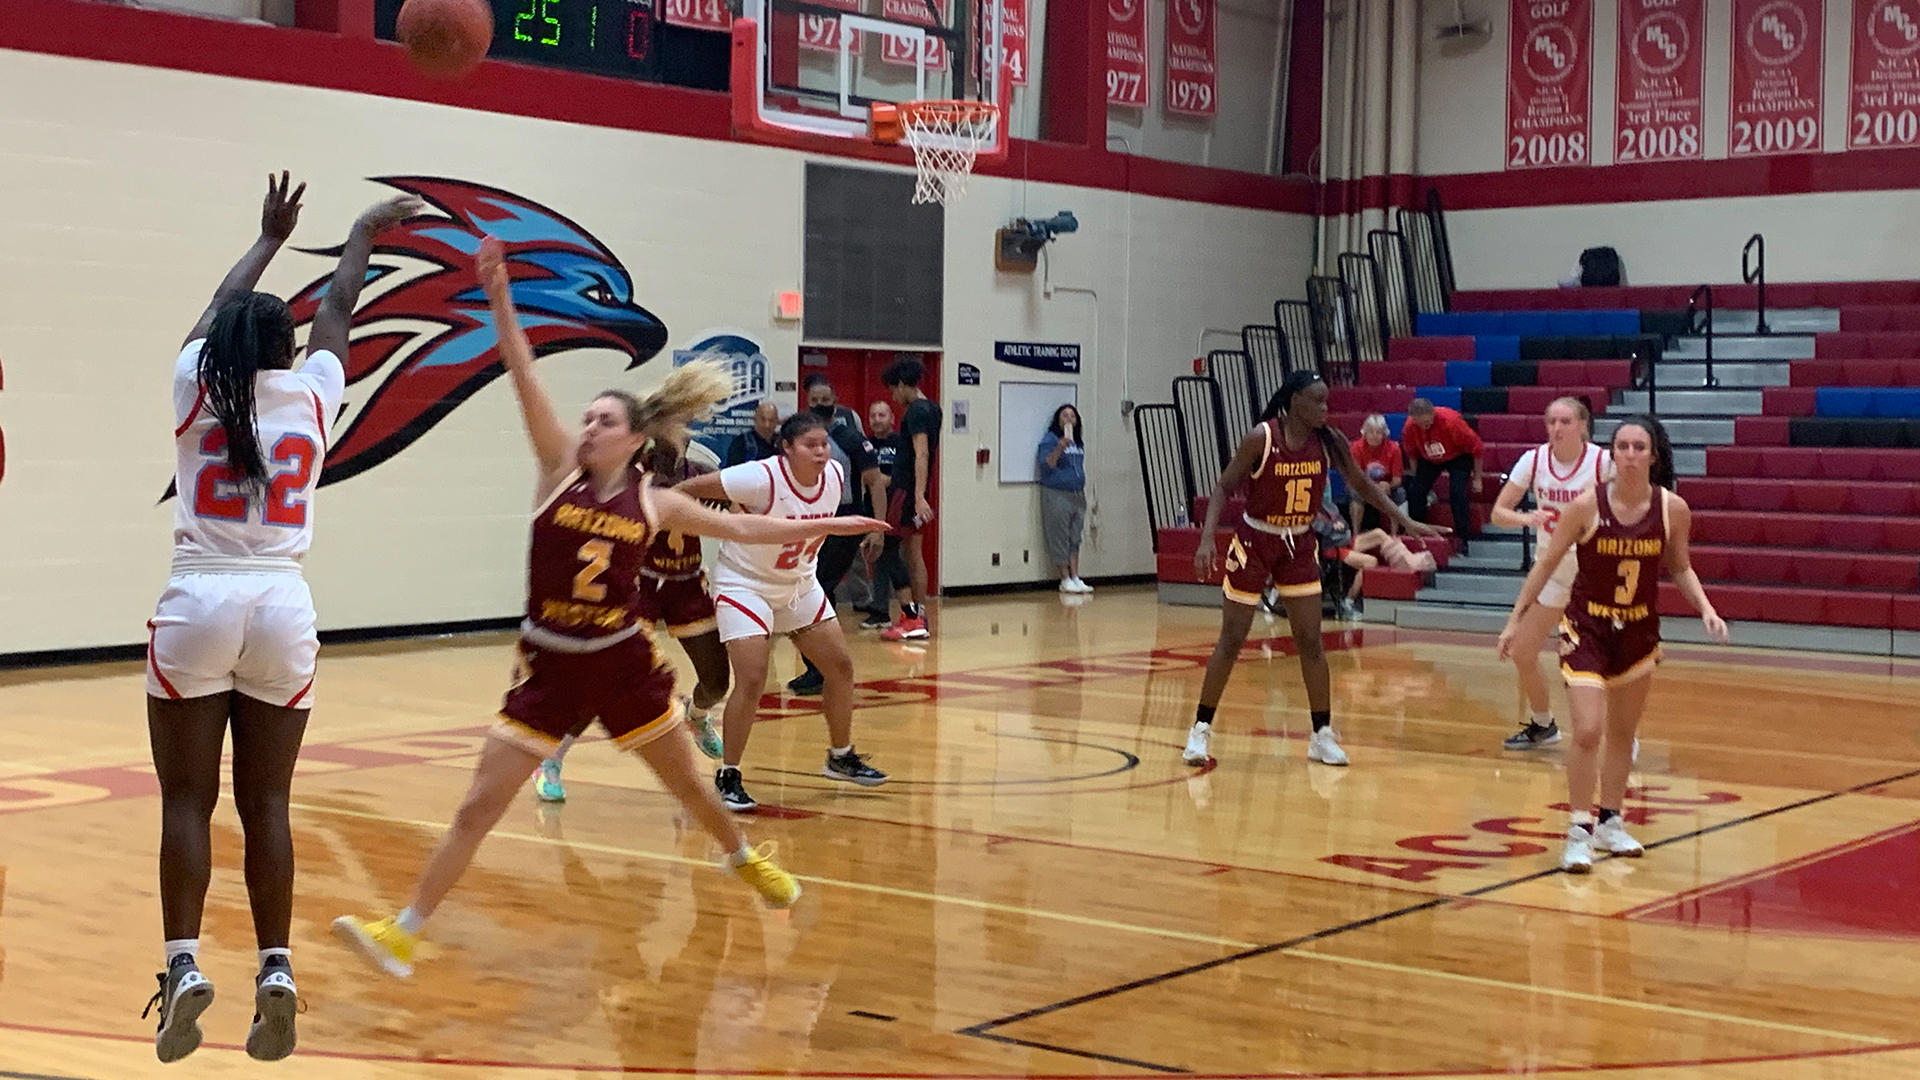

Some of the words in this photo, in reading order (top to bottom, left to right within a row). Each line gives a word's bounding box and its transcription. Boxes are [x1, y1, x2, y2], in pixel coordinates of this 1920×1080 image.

[886, 1, 936, 21] CHAMPION
[1531, 2, 1570, 19] GOLF
[888, 33, 939, 64] 192
[1107, 32, 1138, 49] ATIONAL
[1107, 46, 1144, 63] AMPIONS
[1106, 69, 1141, 101] 977
[1171, 79, 1212, 110] 1979
[1738, 98, 1815, 114] CHAMPIONS
[1893, 90, 1920, 107] Pla
[1513, 113, 1584, 129] CHAMPIONS
[1626, 108, 1651, 126] 3rd
[1655, 108, 1692, 123] Place
[1853, 109, 1920, 145] 200
[1619, 124, 1698, 160] 2008
[1734, 116, 1817, 153] 2009
[1510, 131, 1585, 166] 2008
[1004, 344, 1032, 357] ATHLETIC
[1033, 345, 1060, 358] TRAINING
[1060, 347, 1078, 359] ROOM
[194, 424, 316, 529] 22
[1274, 461, 1322, 477] ARIZONA
[1285, 478, 1313, 514] 15
[1538, 487, 1585, 503] T-BIRD
[553, 502, 646, 545] ARIZONA
[1596, 538, 1662, 556] ARIZONA
[572, 538, 615, 602] 2
[1614, 559, 1641, 606] 3
[1587, 600, 1649, 622] WESTERN
